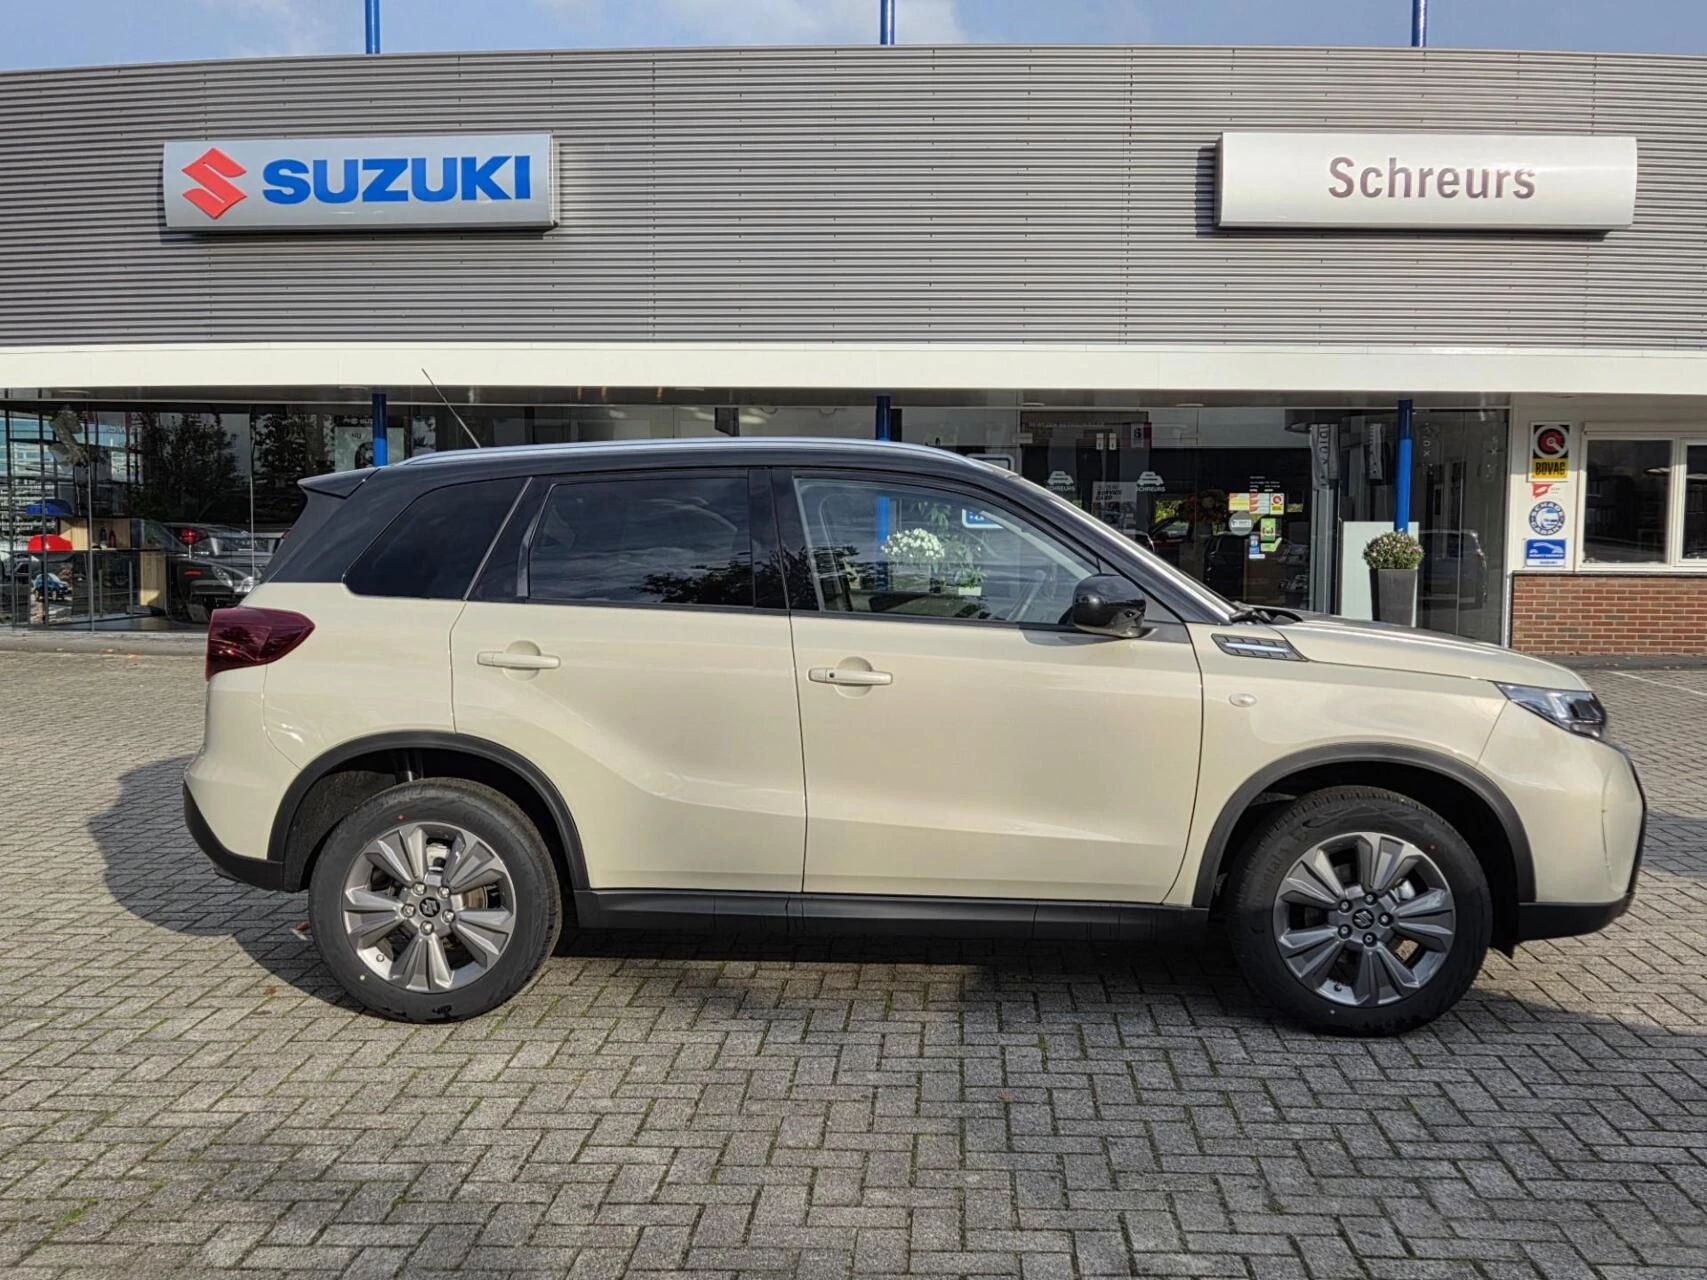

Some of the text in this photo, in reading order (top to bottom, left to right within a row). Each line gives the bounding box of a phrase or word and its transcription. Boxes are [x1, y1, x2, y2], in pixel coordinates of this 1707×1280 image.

[262, 155, 531, 205] SUZUKI
[1328, 156, 1536, 199] Schreurs
[1535, 461, 1566, 476] BOVAG
